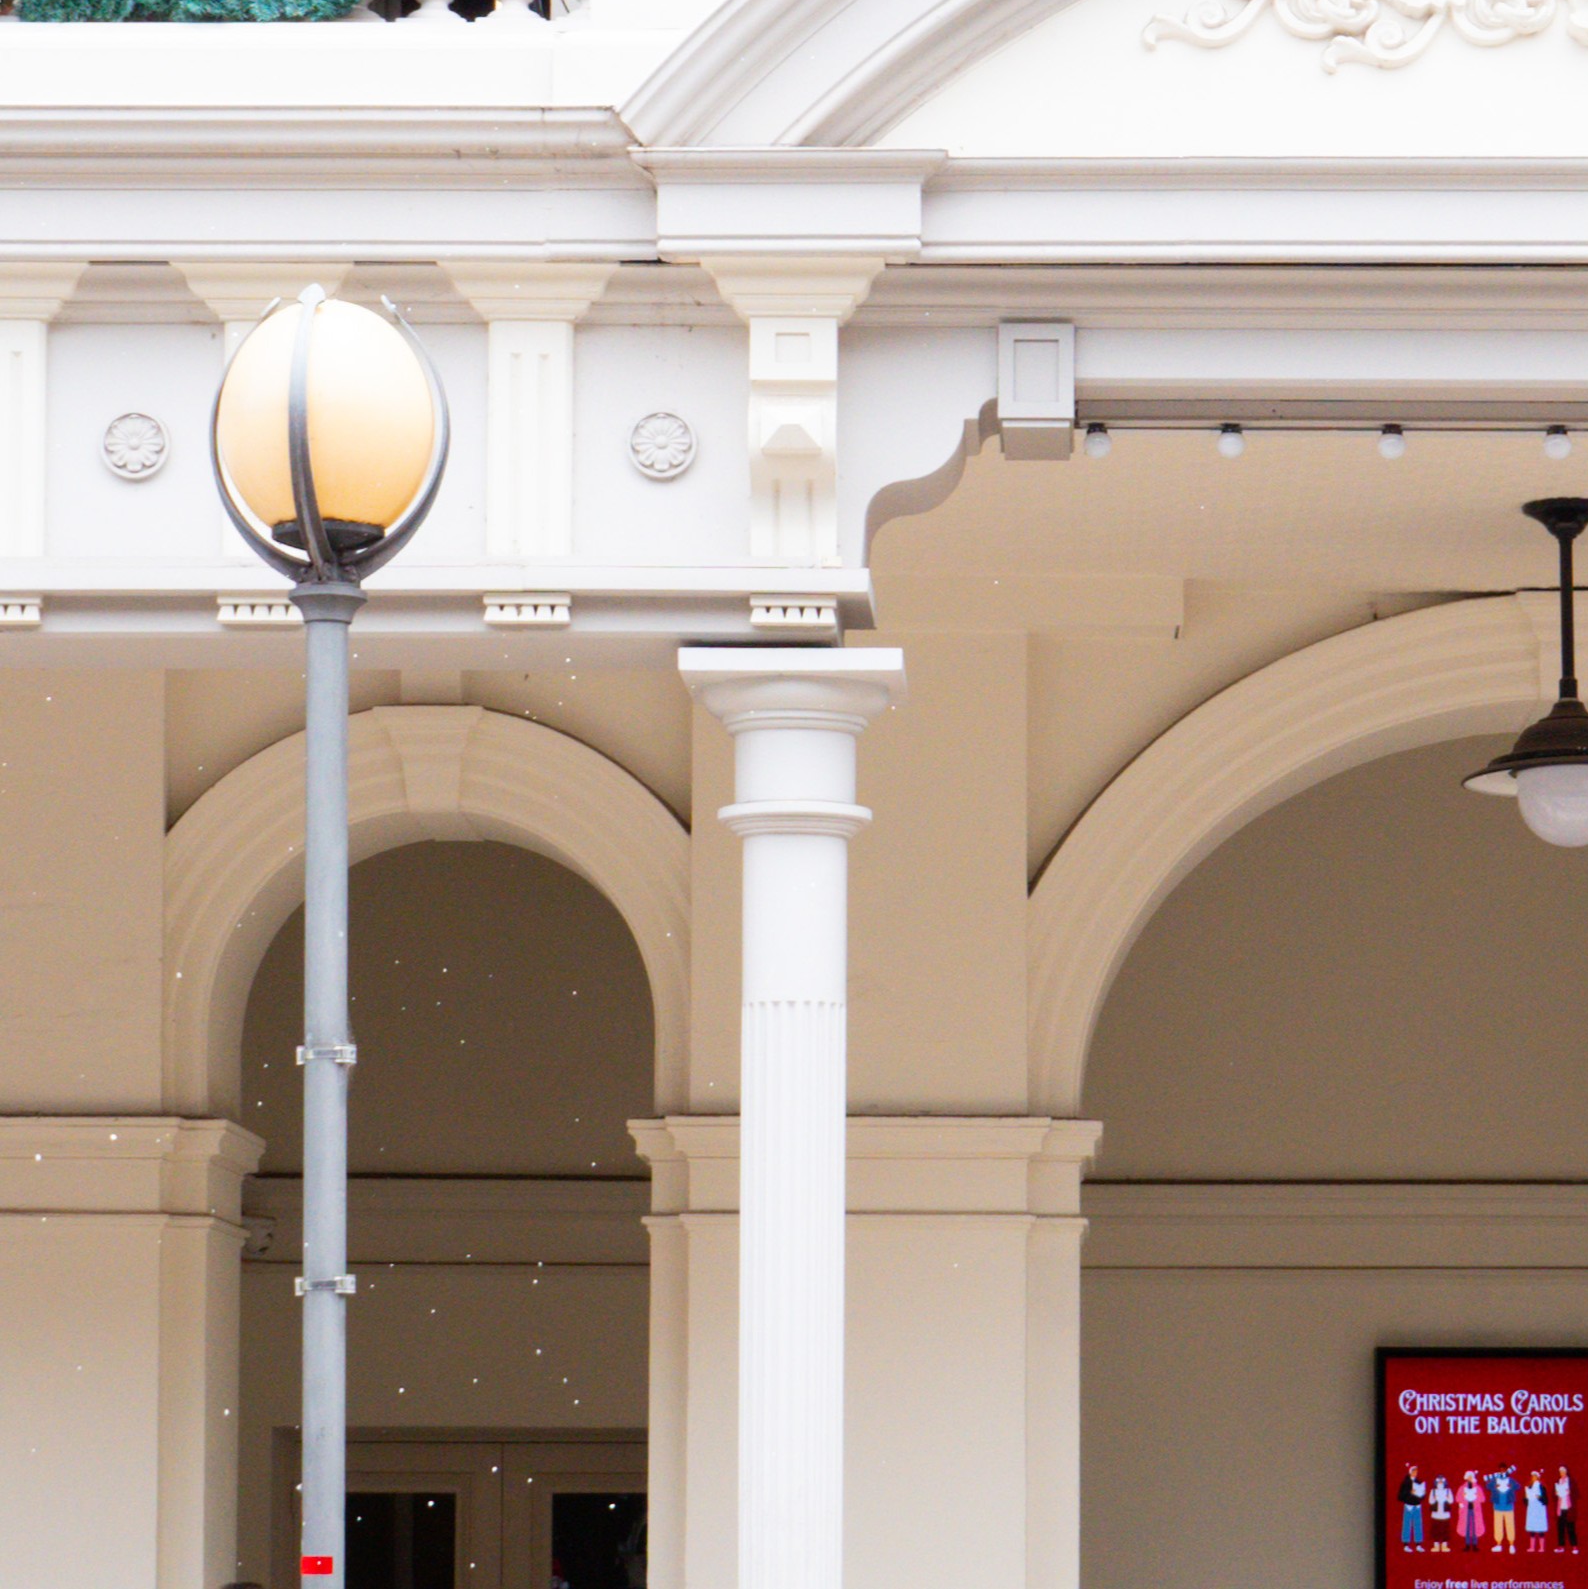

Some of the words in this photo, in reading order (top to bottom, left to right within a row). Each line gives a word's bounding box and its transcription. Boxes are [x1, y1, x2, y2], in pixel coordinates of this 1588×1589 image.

[1398, 1389, 1504, 1415] CHRISTMAS
[1511, 1389, 1584, 1415] CAROLS
[1415, 1416, 1440, 1434] ON
[1446, 1416, 1480, 1434] THE
[1487, 1416, 1567, 1434] BALCONY
[1414, 1579, 1443, 1589] Enjoy
[1445, 1579, 1468, 1589] free
[1470, 1579, 1489, 1589] live
[1490, 1579, 1564, 1589] performances
